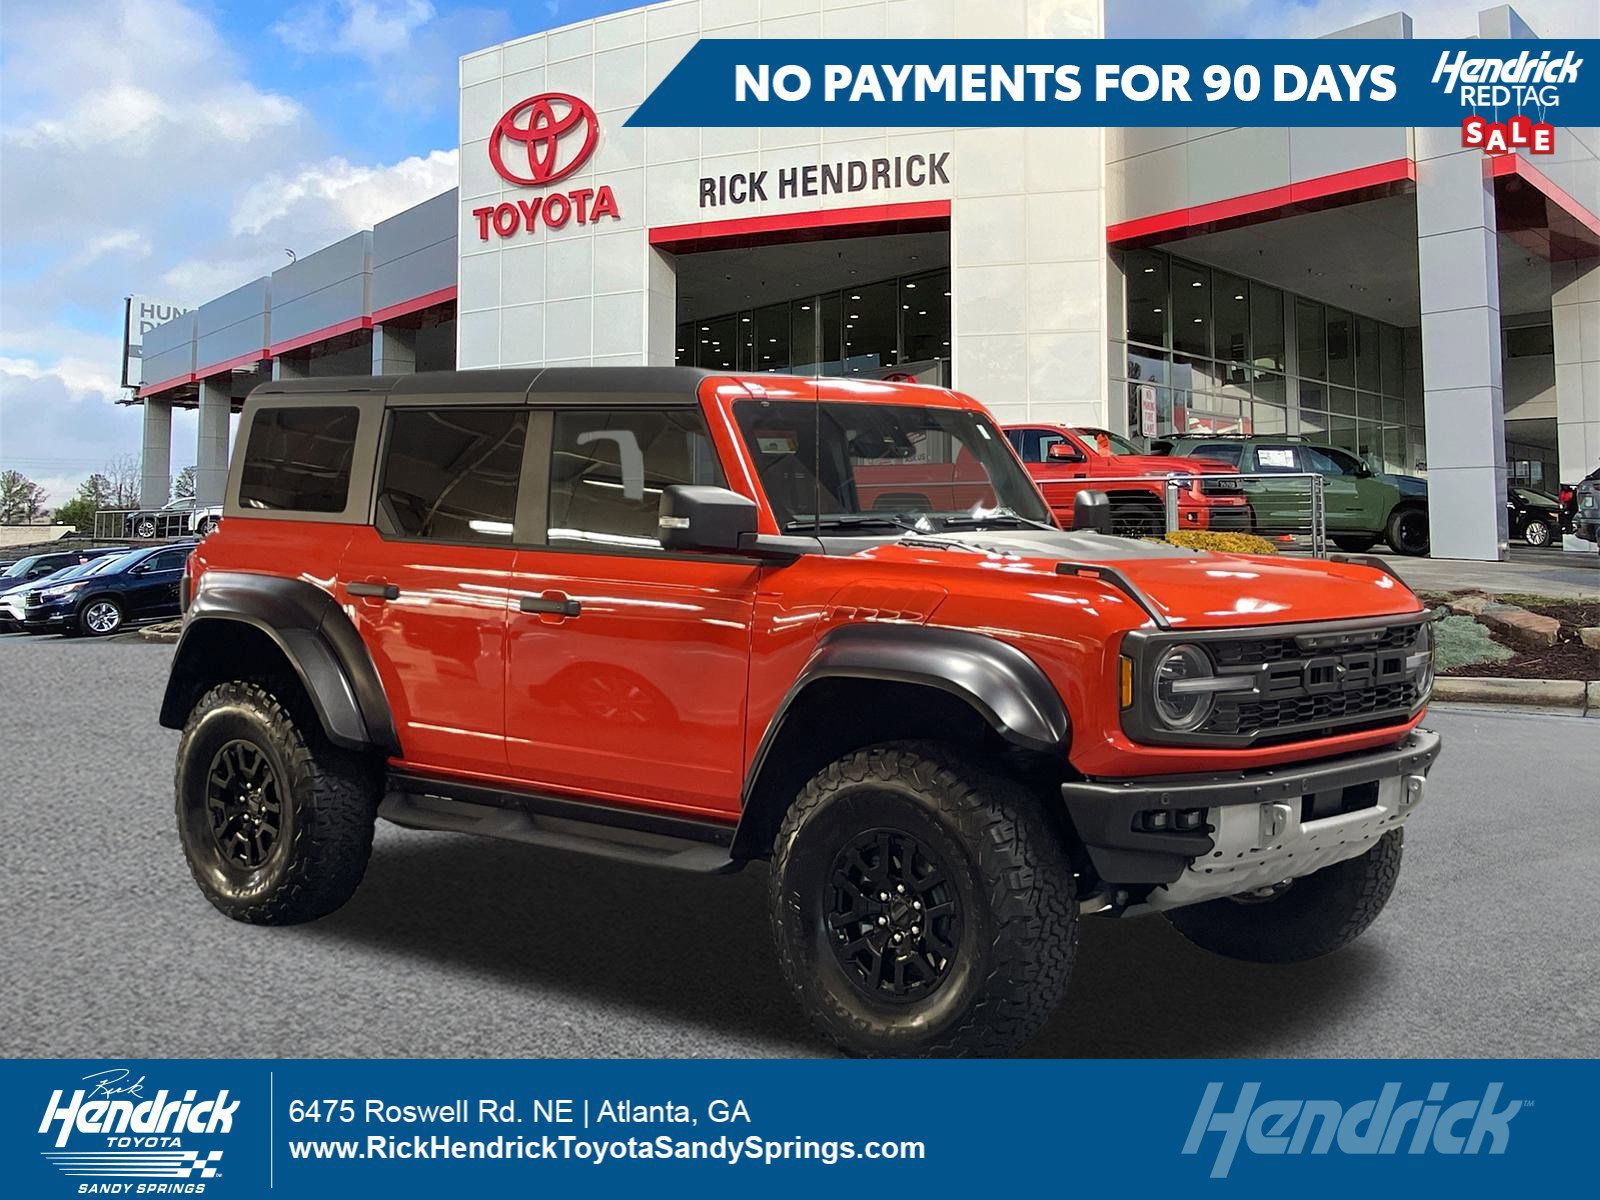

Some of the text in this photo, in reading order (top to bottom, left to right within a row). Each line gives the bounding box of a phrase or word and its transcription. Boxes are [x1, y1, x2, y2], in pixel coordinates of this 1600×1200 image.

[699, 152, 950, 208] RICK HENDRICK
[473, 185, 621, 241] TOYOTA
[1258, 650, 1405, 702] FORD
